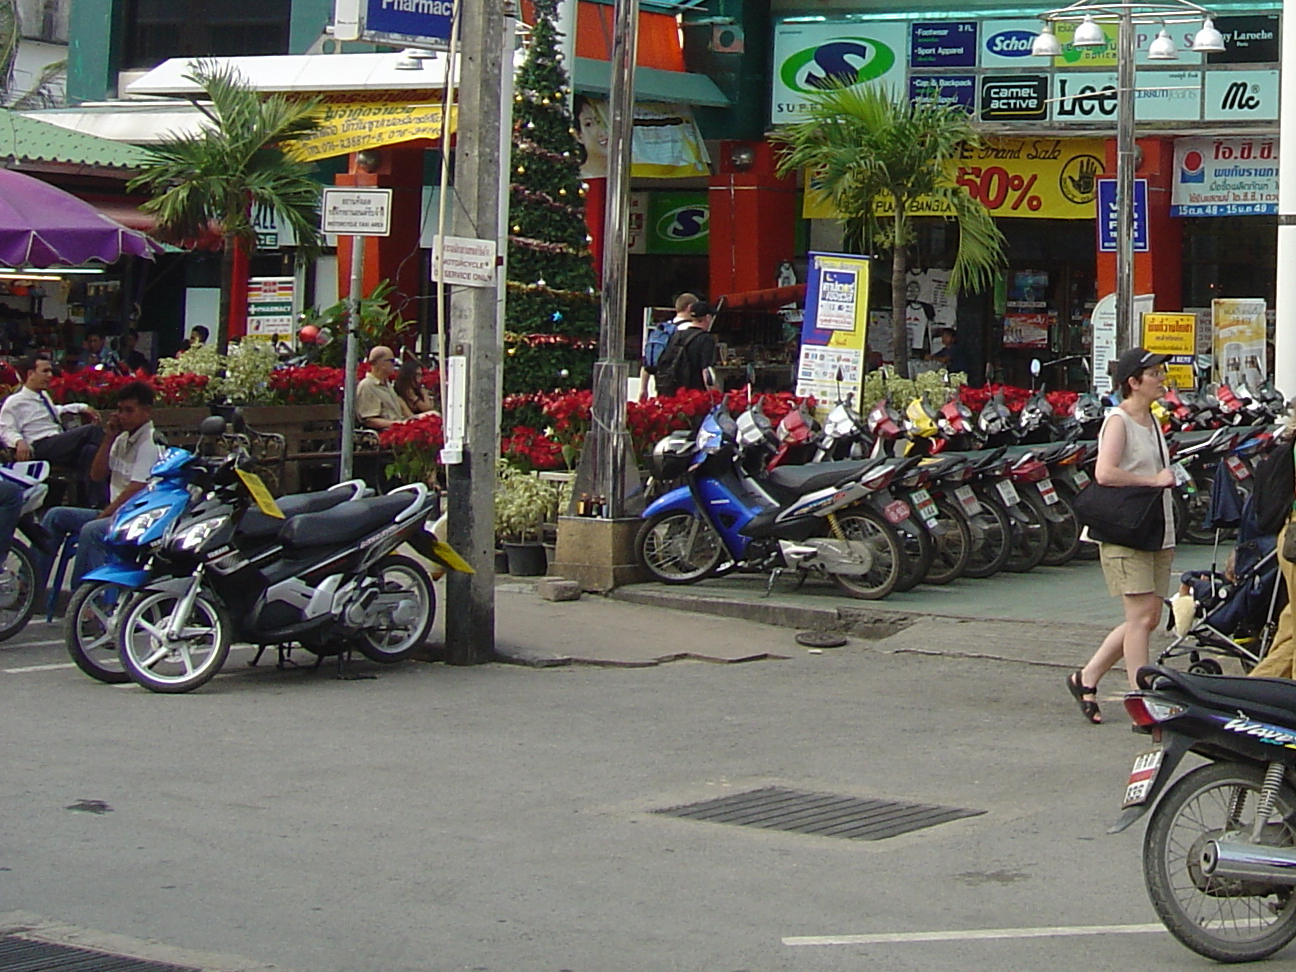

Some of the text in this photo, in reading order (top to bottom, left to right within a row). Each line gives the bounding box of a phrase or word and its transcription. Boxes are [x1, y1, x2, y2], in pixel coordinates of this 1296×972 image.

[1234, 30, 1273, 40] Laroche
[1057, 79, 1118, 116] Lee
[956, 166, 1042, 212] 50%
